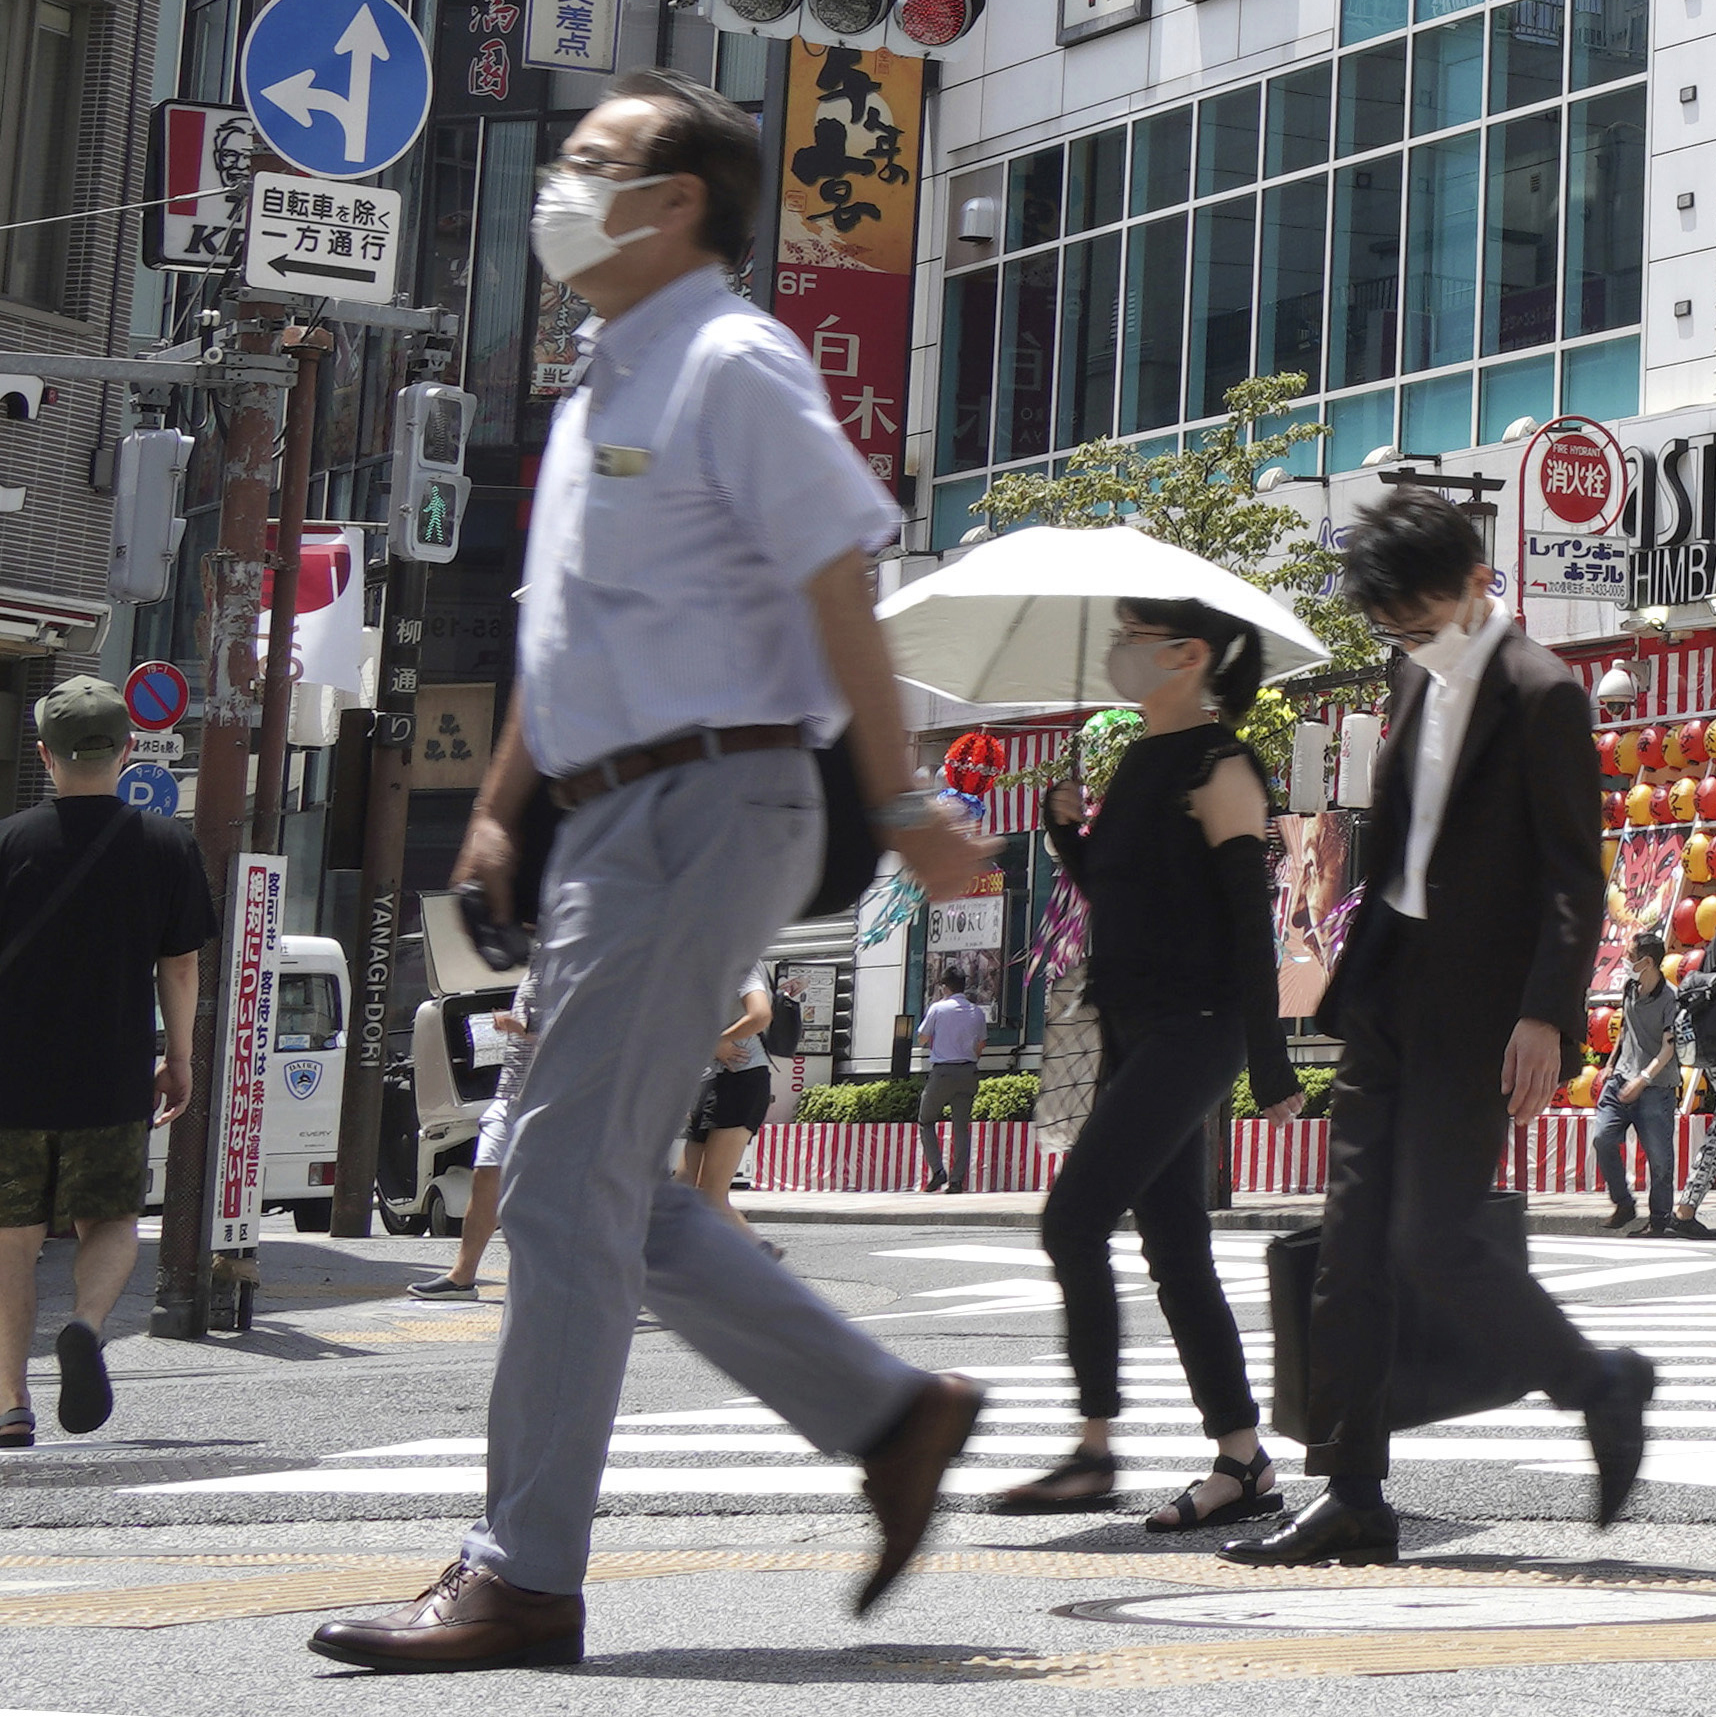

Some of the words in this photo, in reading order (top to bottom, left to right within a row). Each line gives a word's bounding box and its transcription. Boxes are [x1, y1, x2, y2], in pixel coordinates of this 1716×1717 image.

[262, 187, 391, 229] 自転車を除く
[261, 226, 387, 262] 一方通行
[776, 273, 818, 296] 6F
[812, 314, 899, 440] 白木
[1552, 443, 1569, 454] FIRE
[1570, 445, 1602, 458] HYDRANT
[1546, 458, 1607, 499] 消火栓
[1529, 537, 1625, 560] レインボー
[1564, 563, 1625, 584] ホテル
[390, 619, 423, 741] 柳通り
[360, 892, 395, 1067] YANAGI-DORI
